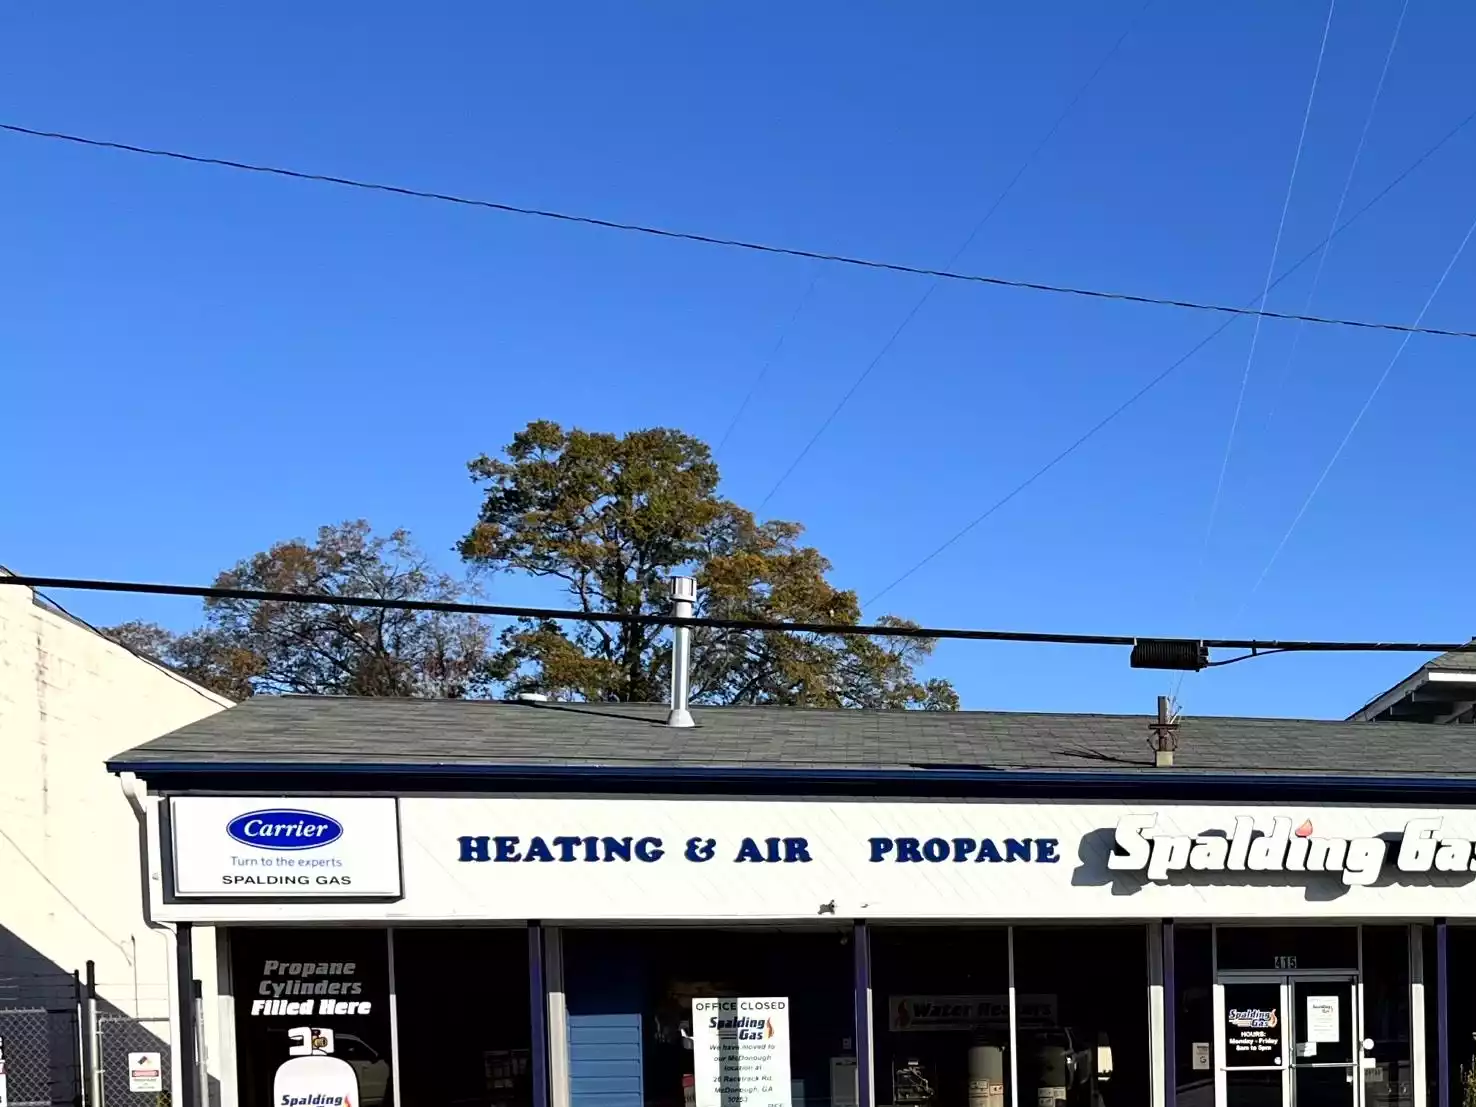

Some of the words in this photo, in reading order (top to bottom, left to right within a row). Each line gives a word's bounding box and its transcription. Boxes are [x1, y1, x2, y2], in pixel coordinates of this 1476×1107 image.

[243, 819, 328, 838] Carrier
[457, 836, 665, 863] HEATING
[684, 837, 717, 863] &
[733, 837, 813, 863] AIR
[867, 837, 1061, 863] PROPANE
[1108, 812, 1389, 885] Spalding
[231, 856, 257, 867] Turn
[262, 857, 273, 867] to
[275, 857, 295, 867] the
[298, 857, 342, 869] experts
[222, 875, 310, 885] SPALDING
[315, 875, 351, 885] GAS
[263, 960, 356, 977] Propane
[259, 980, 362, 998] Cylinders
[251, 999, 314, 1016] Filled
[318, 999, 372, 1016] Here
[695, 1002, 737, 1011] OFFICE
[740, 1001, 786, 1010] CLOSED
[708, 1016, 765, 1030] Spalding
[739, 1029, 763, 1040] Gas
[281, 1094, 343, 1107] Spalding
